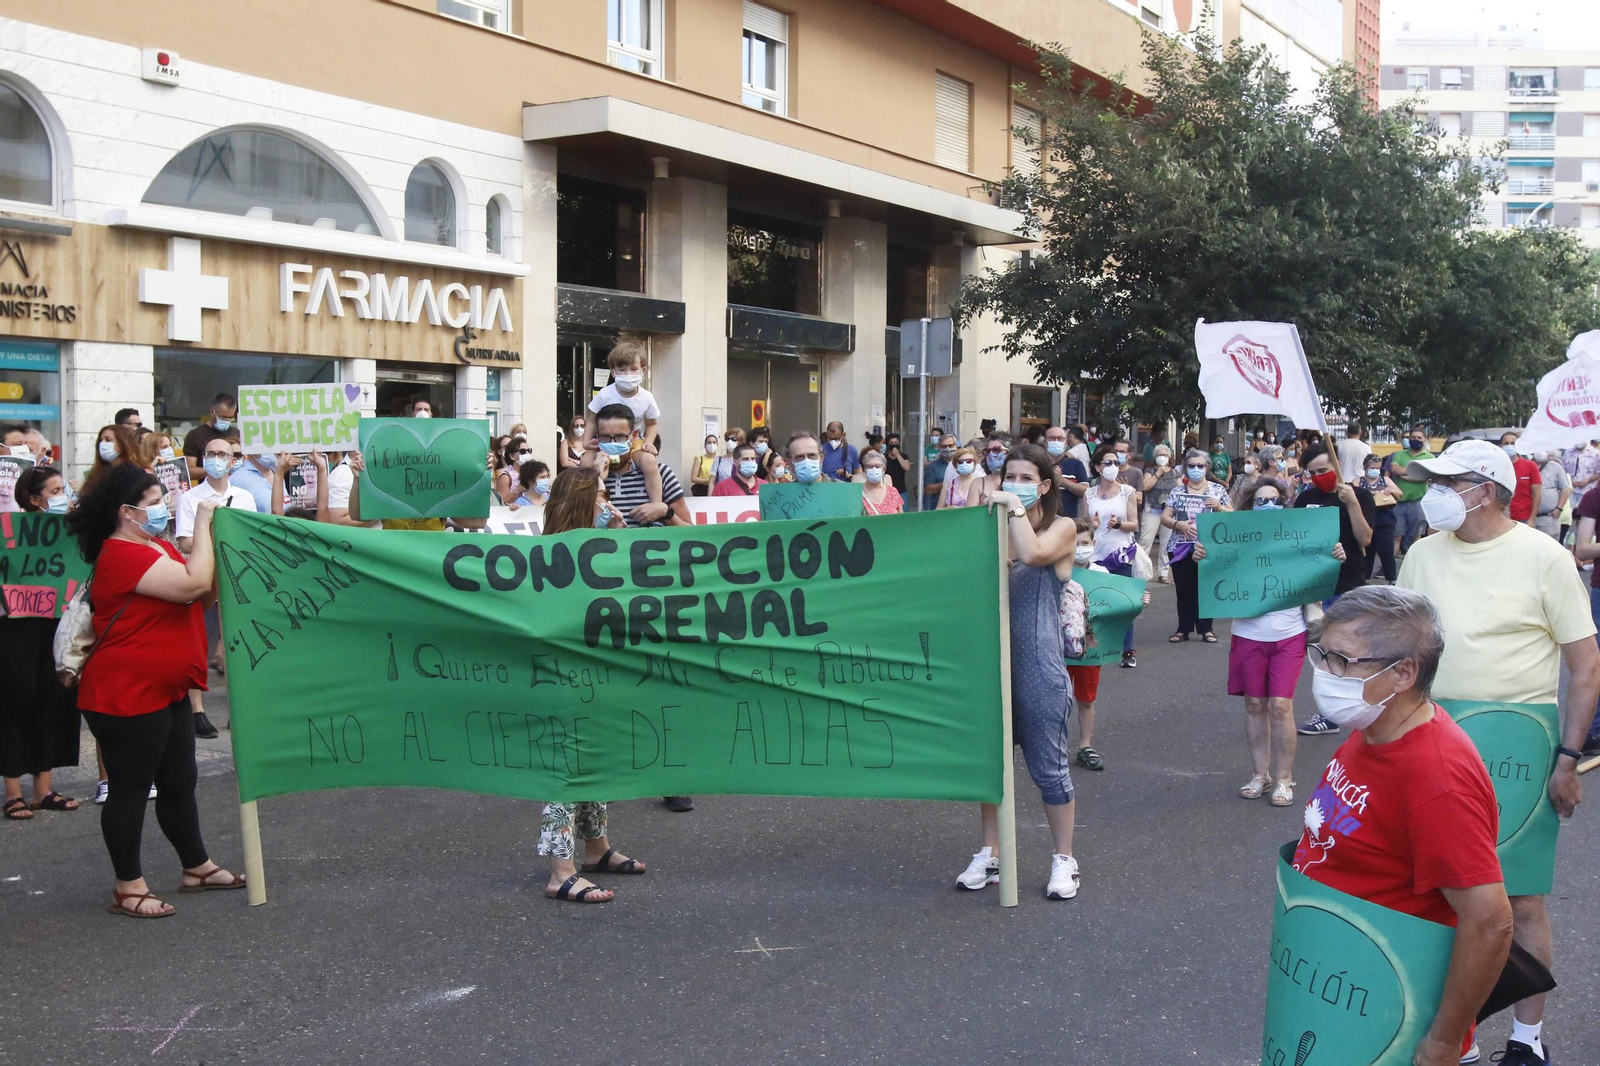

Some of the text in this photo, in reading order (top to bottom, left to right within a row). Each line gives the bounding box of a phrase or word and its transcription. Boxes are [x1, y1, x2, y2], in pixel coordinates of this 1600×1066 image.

[156, 65, 180, 77] EMSA
[279, 262, 514, 332] FARMACIA
[7, 352, 26, 360] UNA
[27, 353, 55, 362] DIETA?
[465, 347, 521, 362] NUTRIFARMA
[239, 387, 345, 417] ESCUELA
[243, 417, 353, 448] PUBLICA
[292, 486, 308, 496] NO
[780, 488, 816, 520] PALMA
[1210, 521, 1311, 549] Quiero elegir
[20, 553, 66, 579] LOS
[219, 518, 332, 605] AMPA
[443, 521, 876, 592] CONCEPCIÓN
[1254, 555, 1273, 568] mi
[1213, 579, 1250, 602] Cole
[584, 587, 829, 649] ARENAL
[530, 652, 615, 704] Elegir
[635, 650, 693, 688] Mi
[307, 697, 894, 777] NO AL CIERRE DE AULAS
[1482, 755, 1532, 782] ión
[1270, 938, 1369, 1017] cación
